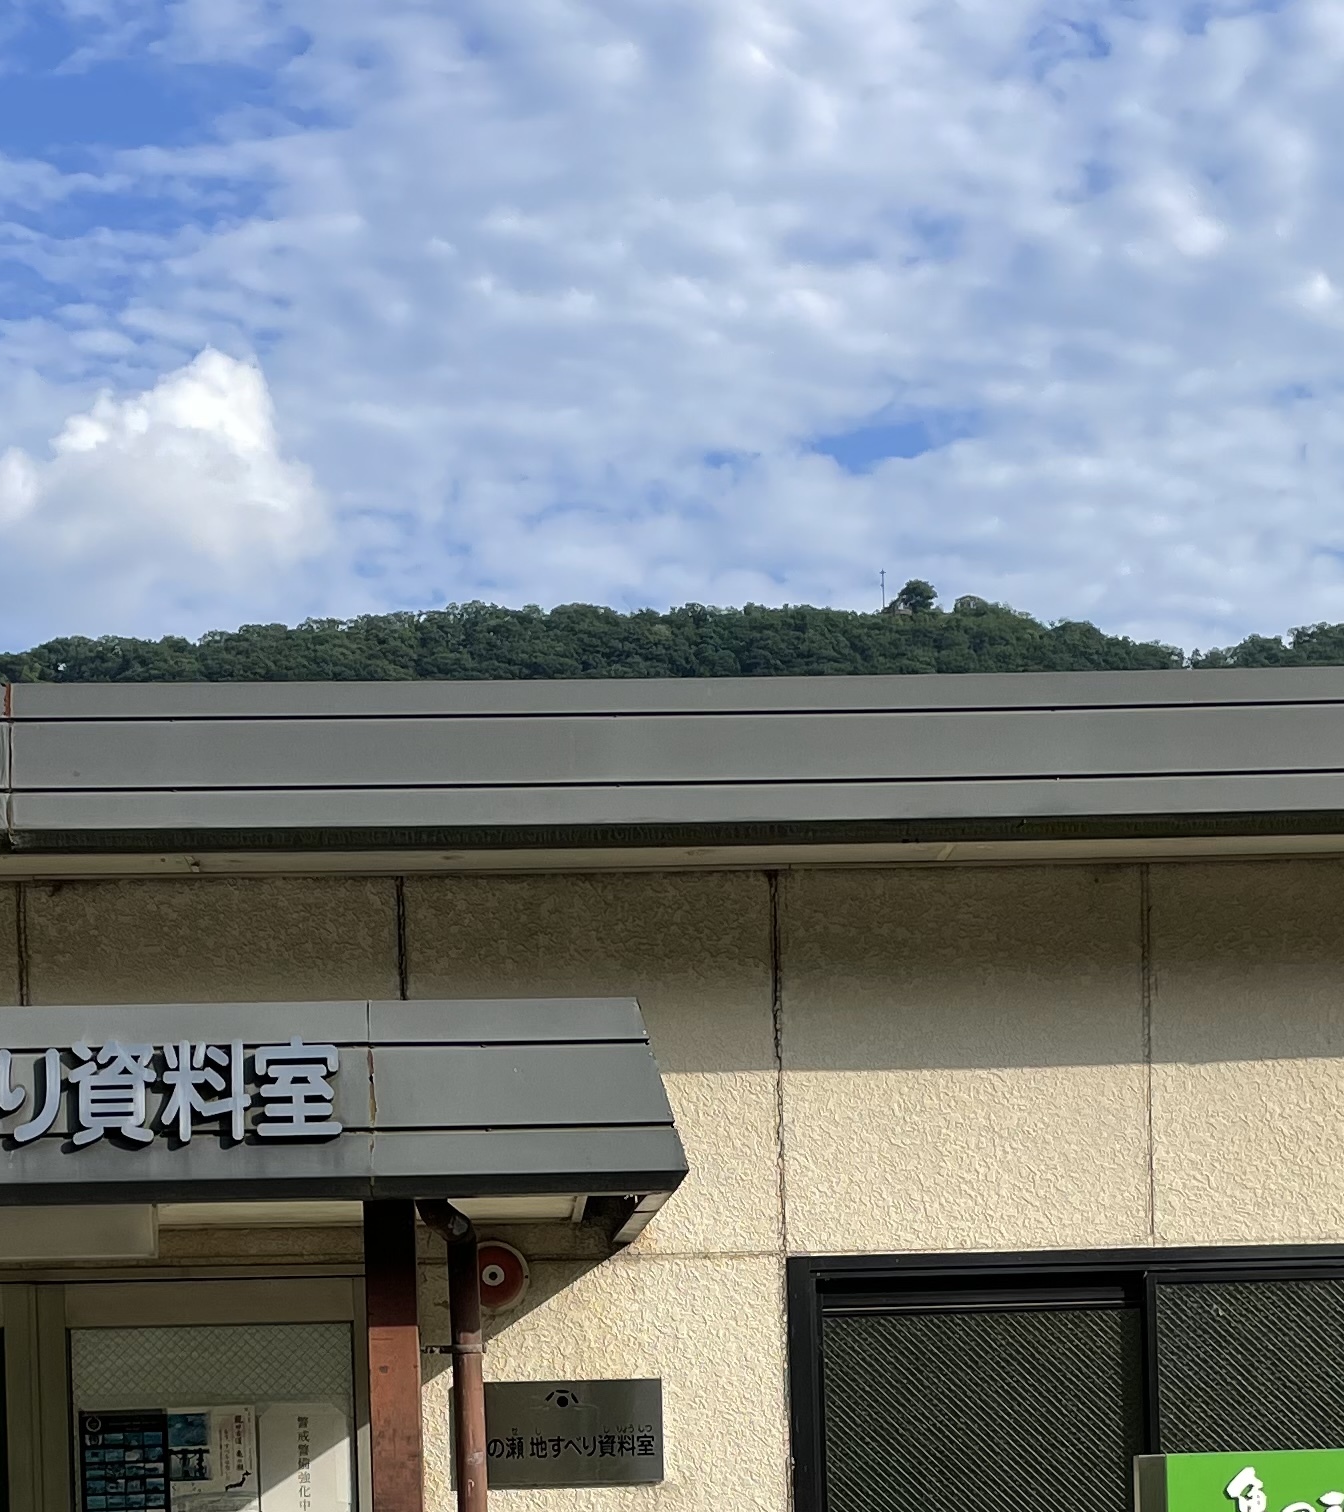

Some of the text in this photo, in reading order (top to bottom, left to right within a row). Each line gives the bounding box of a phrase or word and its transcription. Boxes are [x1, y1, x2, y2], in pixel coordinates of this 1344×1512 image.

[487, 1433, 656, 1460] の瀬 地すべり資料室
